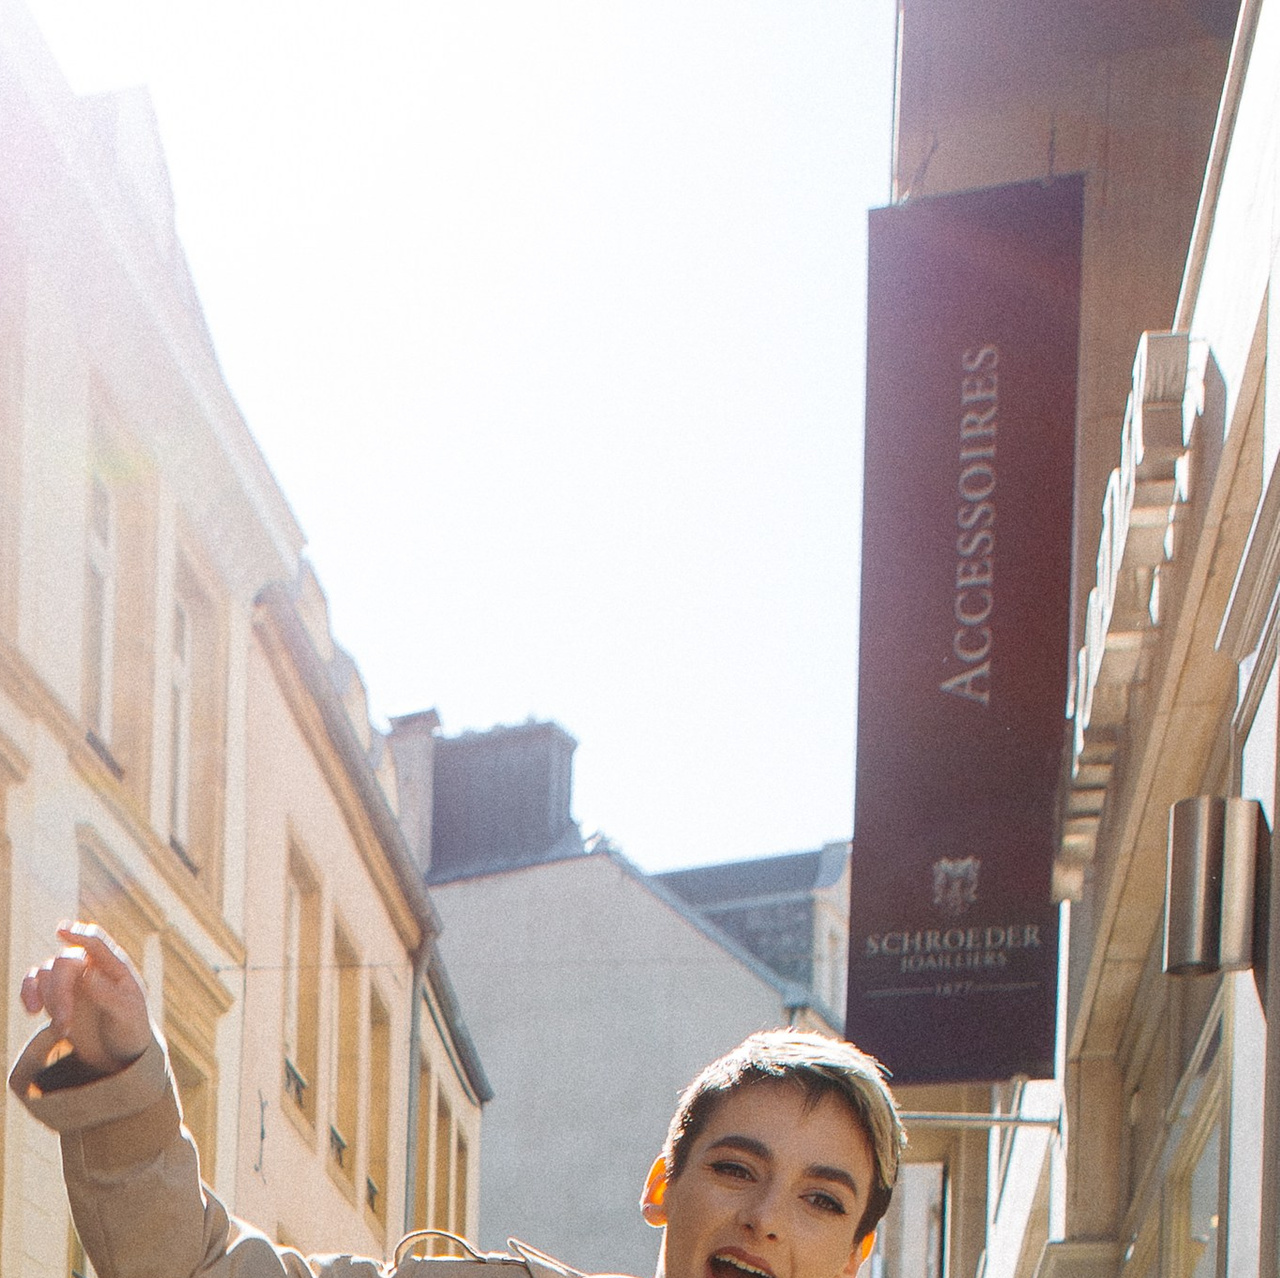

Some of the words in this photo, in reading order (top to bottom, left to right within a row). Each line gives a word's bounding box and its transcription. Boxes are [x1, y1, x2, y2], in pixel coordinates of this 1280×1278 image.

[939, 343, 999, 708] ACCESSOIRES
[865, 924, 1043, 957] SCHROEDER
[900, 950, 1008, 974] JOAILLIERS
